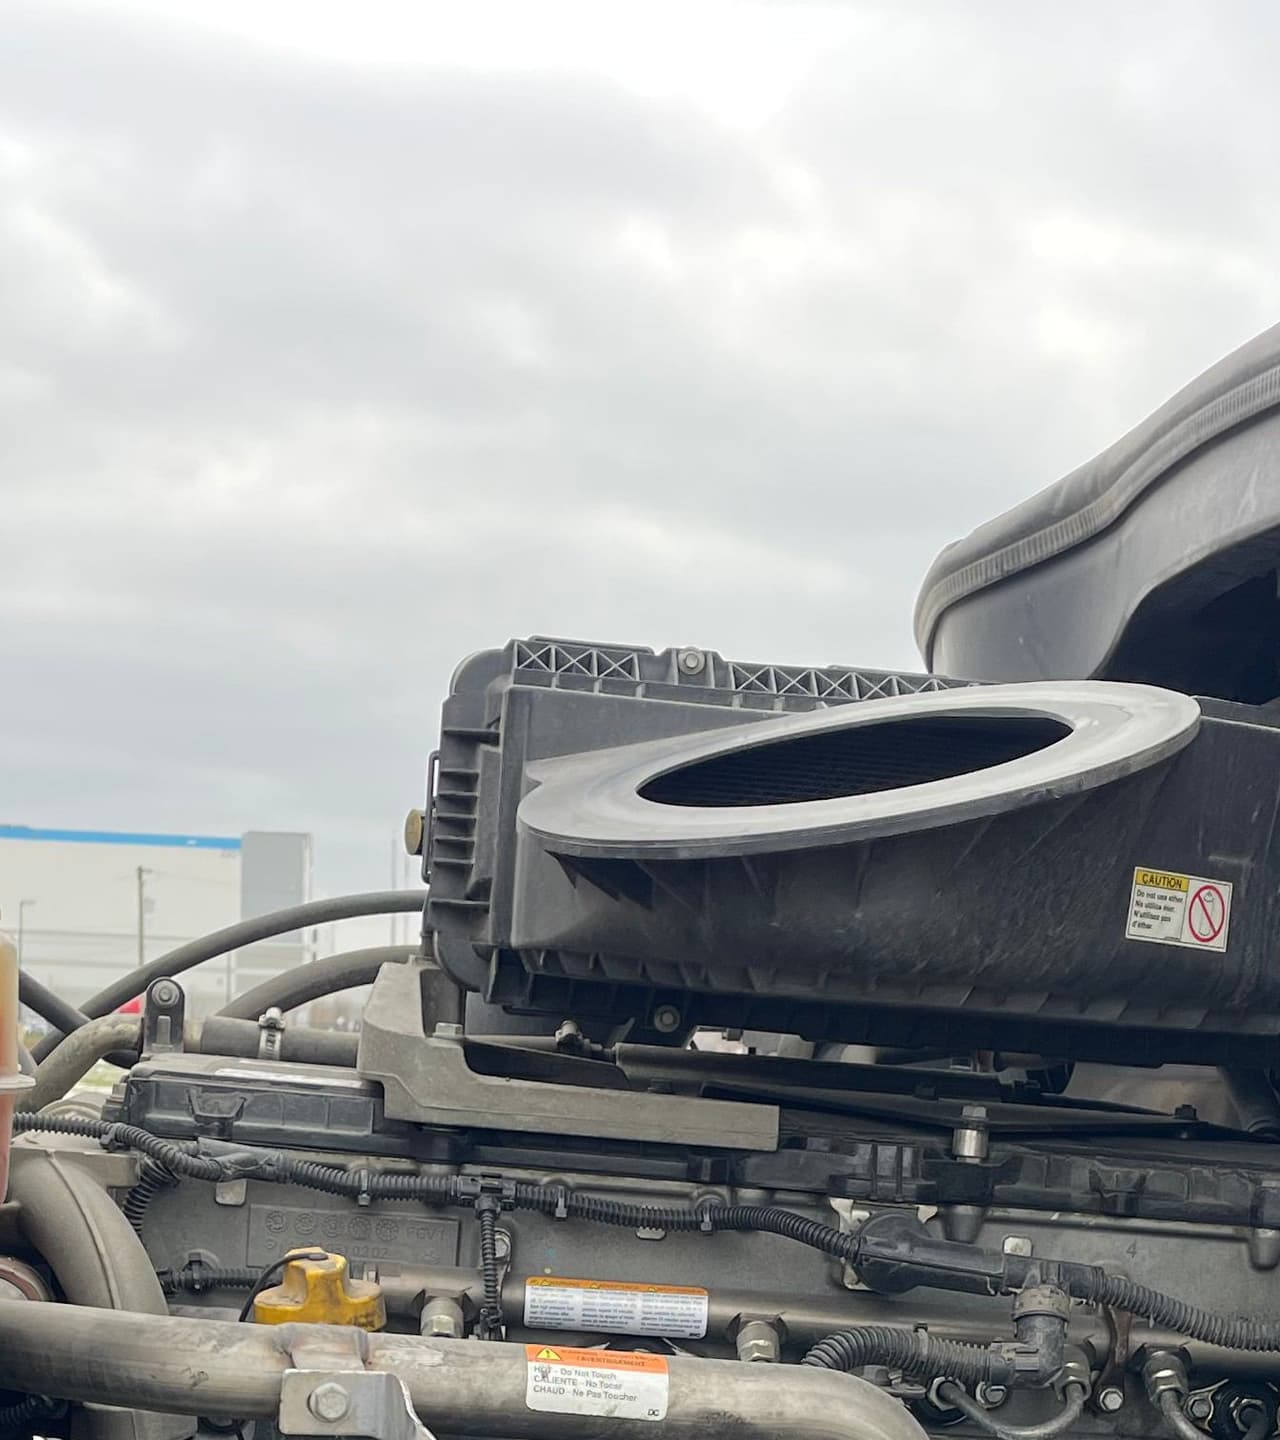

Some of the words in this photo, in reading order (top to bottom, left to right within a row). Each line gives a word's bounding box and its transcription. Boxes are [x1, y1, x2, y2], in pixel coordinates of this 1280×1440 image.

[1142, 874, 1182, 888] CAUTION
[592, 1370, 617, 1380] Touch
[534, 1376, 578, 1386] CALIENTE
[585, 1379, 597, 1387] No
[533, 1385, 565, 1395] CHAUD
[586, 1389, 602, 1398] Pas
[604, 1391, 637, 1402] Toucher
[648, 1408, 659, 1416] DC
